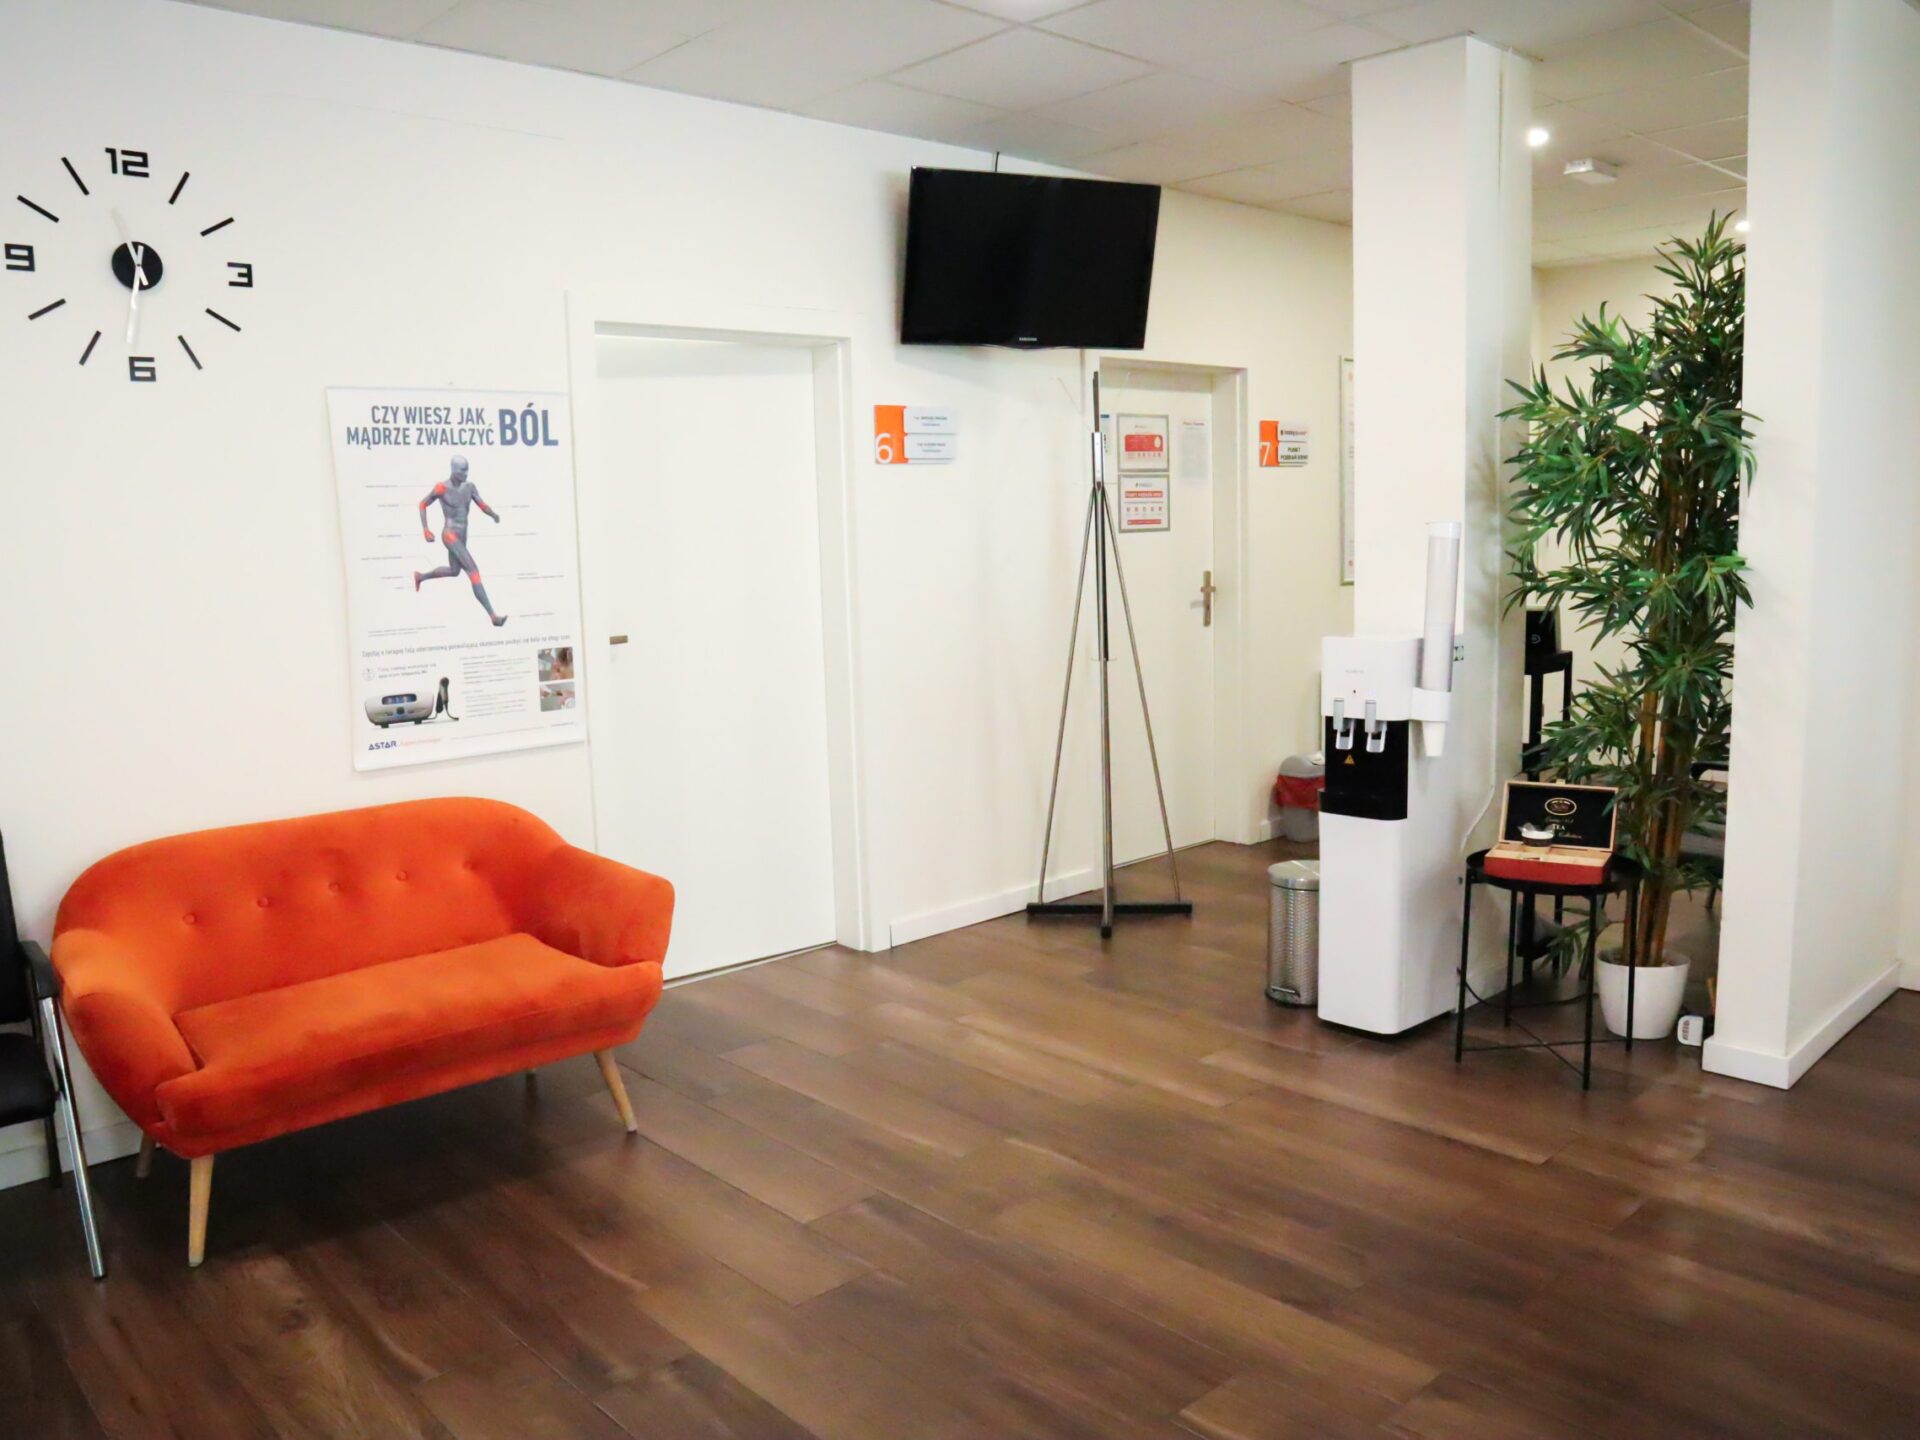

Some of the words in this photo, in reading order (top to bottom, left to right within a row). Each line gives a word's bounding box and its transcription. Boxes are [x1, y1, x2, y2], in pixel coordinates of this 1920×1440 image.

[105, 147, 150, 178] 12
[4, 243, 35, 272] 9
[227, 262, 253, 288] 3
[128, 356, 156, 382] 6
[371, 405, 399, 424] CZY
[404, 406, 451, 425] WIESZ
[457, 408, 486, 425] JAK
[498, 402, 559, 447] BÓL
[346, 426, 411, 449] MĄDRZE
[416, 423, 495, 446] ZWALCZYĆ
[874, 432, 894, 464] 6
[1260, 441, 1271, 466] 7
[368, 740, 397, 751] ASTAR
